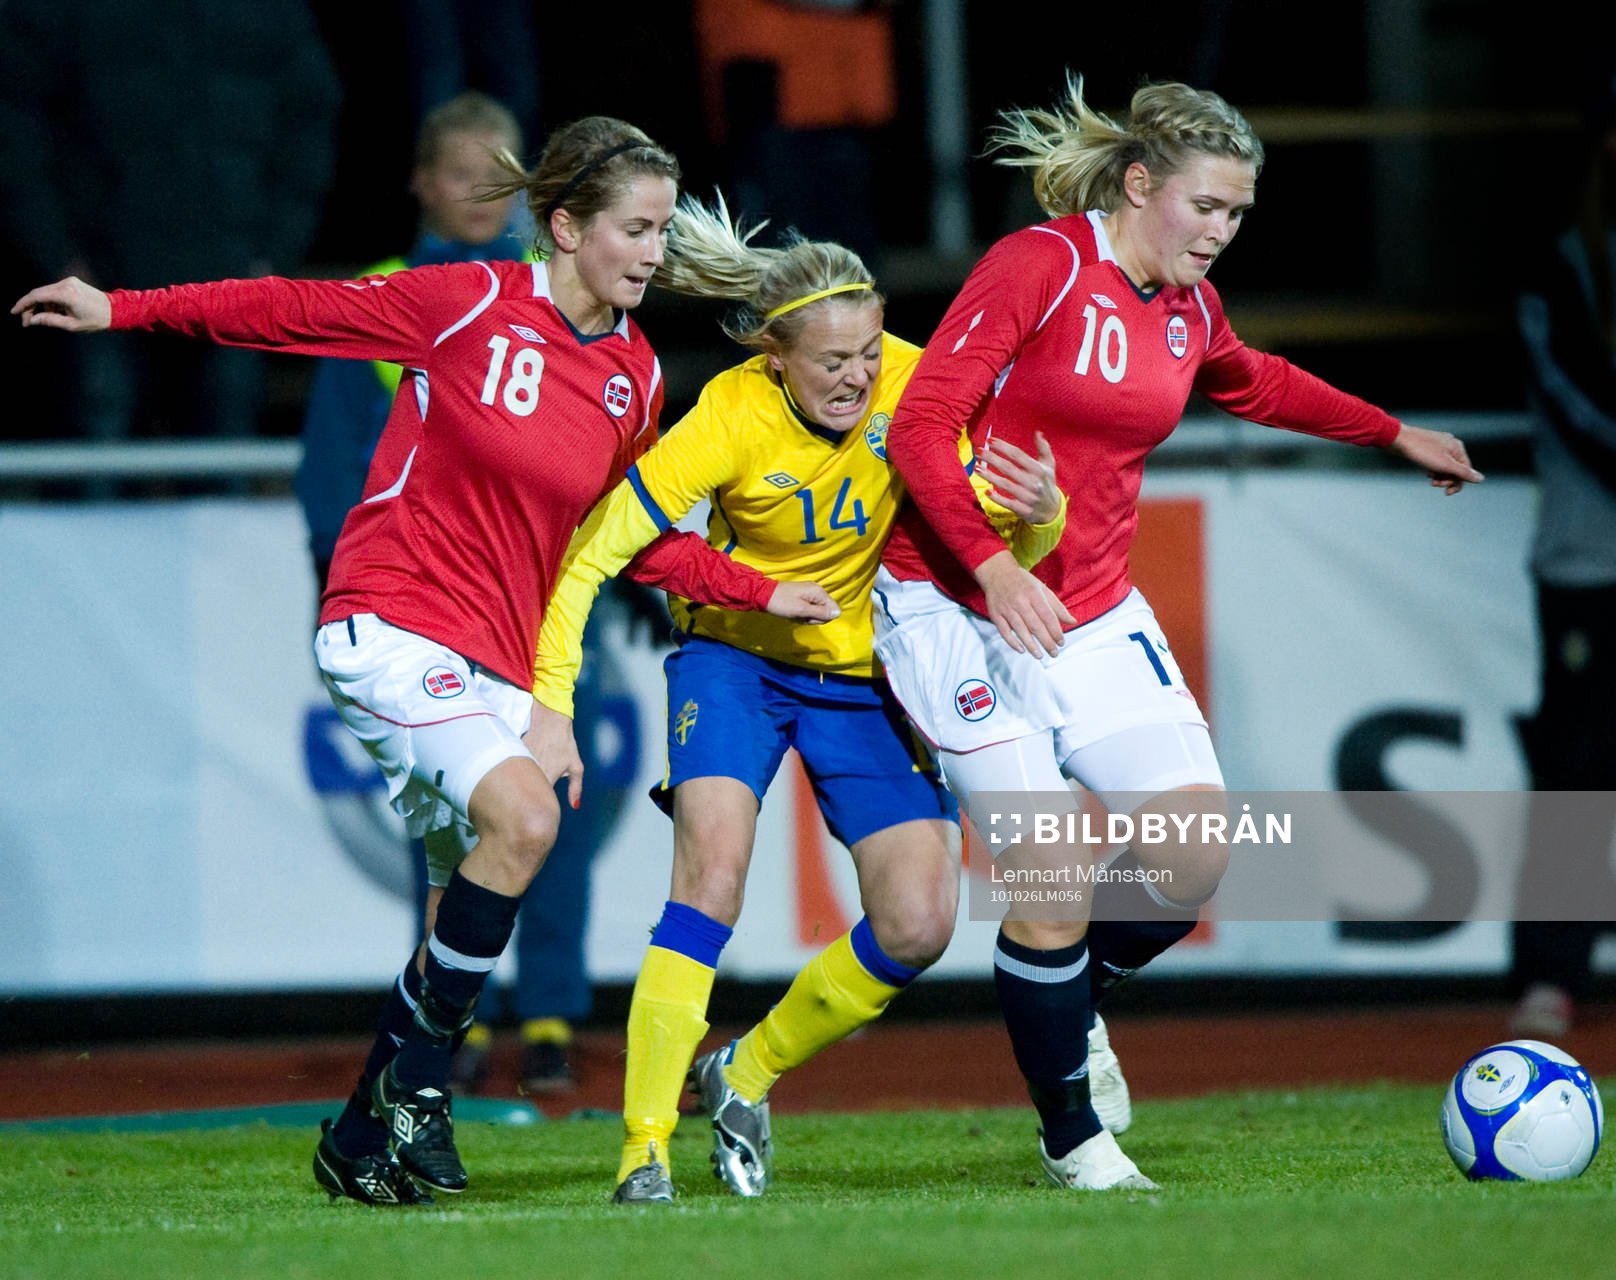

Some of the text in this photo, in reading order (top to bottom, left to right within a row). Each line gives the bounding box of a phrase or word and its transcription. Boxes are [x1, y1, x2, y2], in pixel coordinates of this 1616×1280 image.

[480, 334, 545, 417] 18
[1074, 304, 1128, 384] 10
[795, 477, 871, 545] 14
